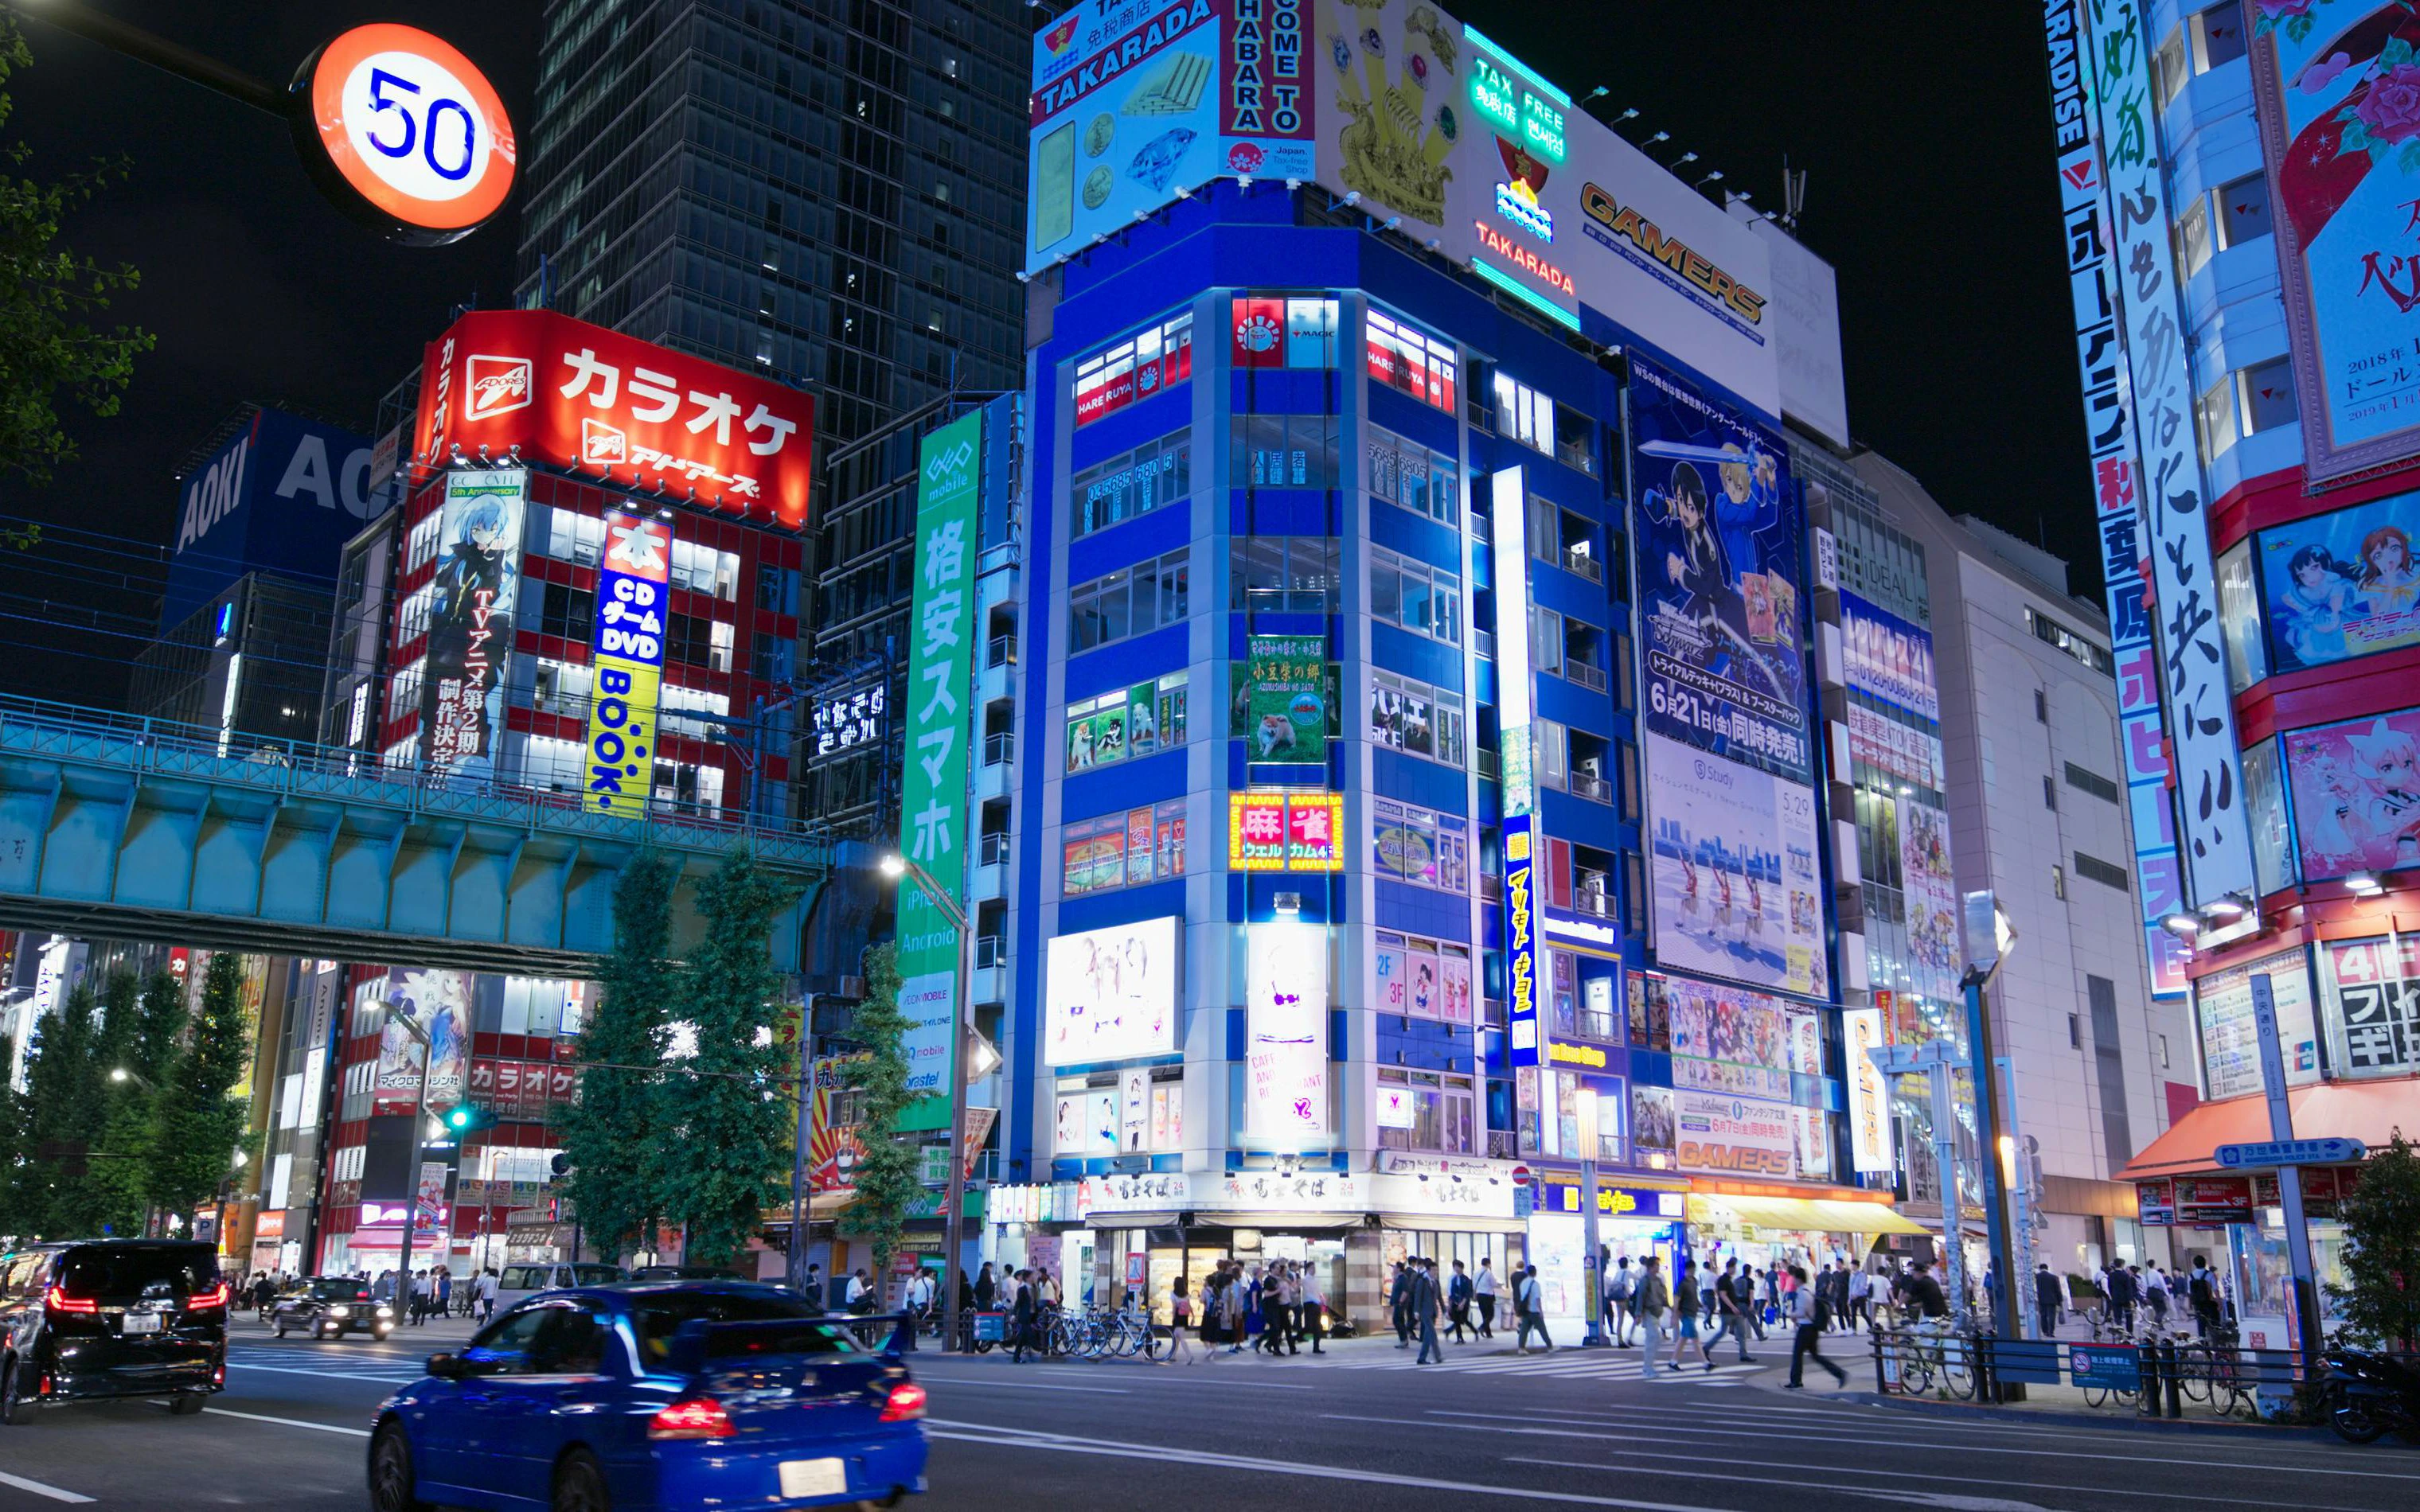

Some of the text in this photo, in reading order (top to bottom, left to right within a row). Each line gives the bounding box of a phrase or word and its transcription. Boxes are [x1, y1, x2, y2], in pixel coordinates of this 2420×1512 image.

[1040, 2, 1212, 115] TAKARADA
[2043, 0, 2084, 148] ARADISE
[1274, 85, 1301, 133] TO
[1476, 57, 1563, 131] TAX FREE
[366, 68, 475, 181] 50
[1475, 220, 1575, 296] TAKARADA
[1581, 182, 1768, 325] GAMERS
[429, 337, 455, 464] カラオケ
[559, 348, 797, 456] カラオケ
[451, 487, 520, 497] 5th Anniversary
[630, 444, 758, 497] アドアーズ
[928, 474, 969, 502] mobile
[177, 435, 249, 555] AOKI
[609, 526, 666, 571] 本
[614, 579, 656, 605] CD
[603, 601, 662, 635] ゲーム
[602, 629, 659, 660] DVD
[456, 589, 494, 755] TVアニメ第2期
[912, 516, 966, 861] 格安スマホ
[590, 668, 631, 793] BOOK
[1707, 766, 1735, 789] Study
[1239, 805, 1329, 841] 麻雀
[1783, 792, 1809, 817] 5.29
[902, 926, 955, 953] Android
[1509, 868, 1530, 1012] マツモトキヨシ
[1377, 956, 1392, 976] 2F
[1390, 983, 1403, 1004] 3F
[380, 1074, 459, 1088] マイクロマジン社
[473, 1068, 572, 1093] カラオケ
[1678, 1140, 1792, 1175] GAMERS
